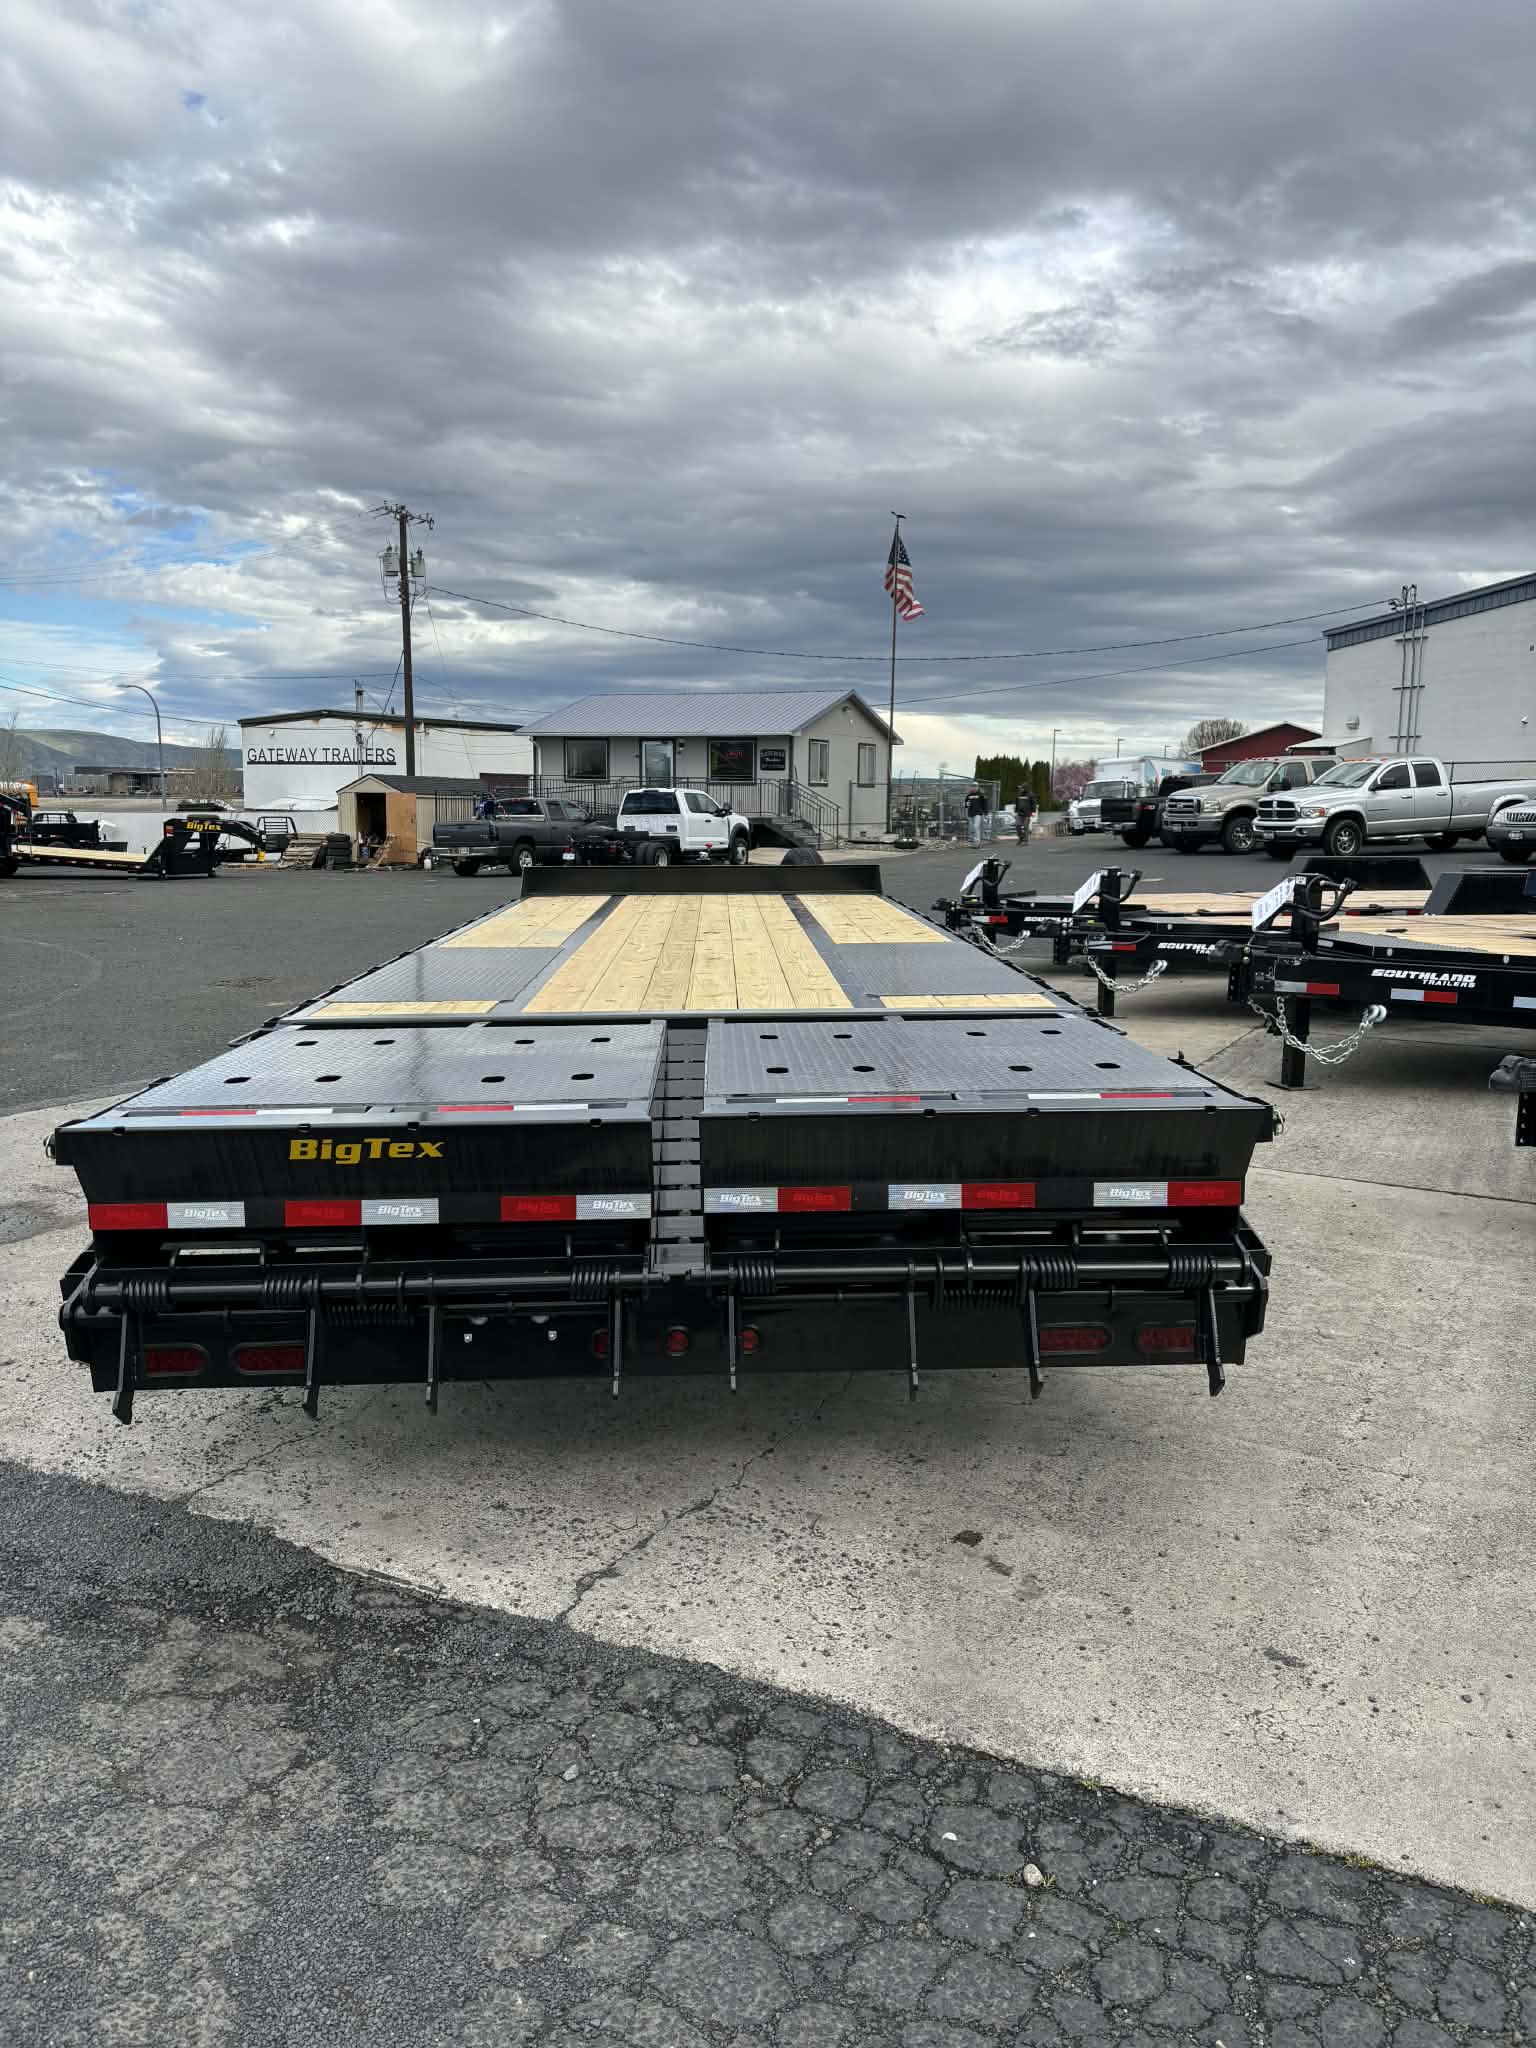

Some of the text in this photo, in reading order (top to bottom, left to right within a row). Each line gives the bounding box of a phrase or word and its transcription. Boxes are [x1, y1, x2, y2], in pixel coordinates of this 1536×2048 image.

[247, 748, 396, 762] GATEWAY TRAILERS
[186, 822, 222, 831] BigTex
[1371, 968, 1476, 983] SOUTHLAND
[1422, 980, 1476, 988] TRAILERS
[289, 1138, 444, 1164] BigTex
[904, 1191, 946, 1201] BigTex
[378, 1205, 423, 1216] BigTex
[593, 1200, 636, 1211] BigTex
[183, 1208, 229, 1218] BigTex
